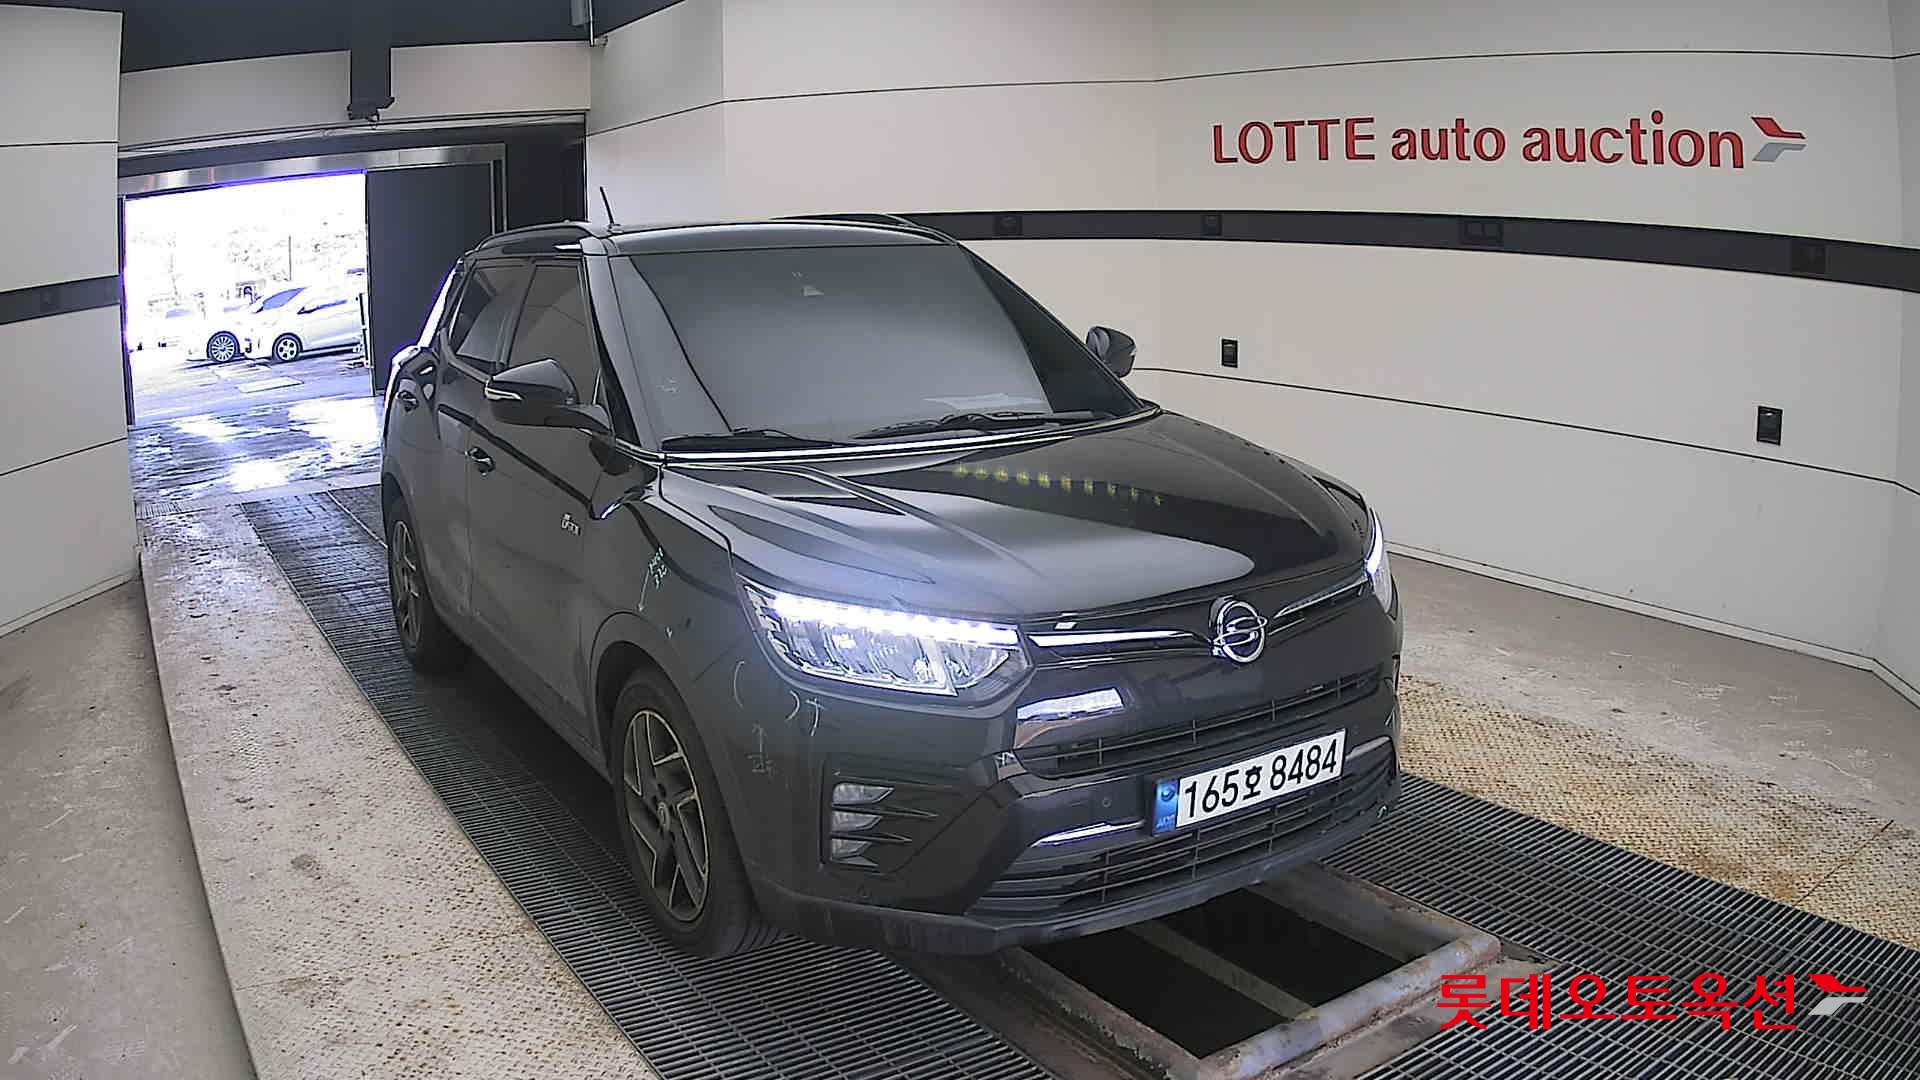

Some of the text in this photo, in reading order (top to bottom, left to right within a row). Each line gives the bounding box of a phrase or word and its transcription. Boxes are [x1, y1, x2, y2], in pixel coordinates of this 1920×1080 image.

[1212, 111, 1746, 169] LOTTE auto auction
[1184, 738, 1338, 818] 165호 8484
